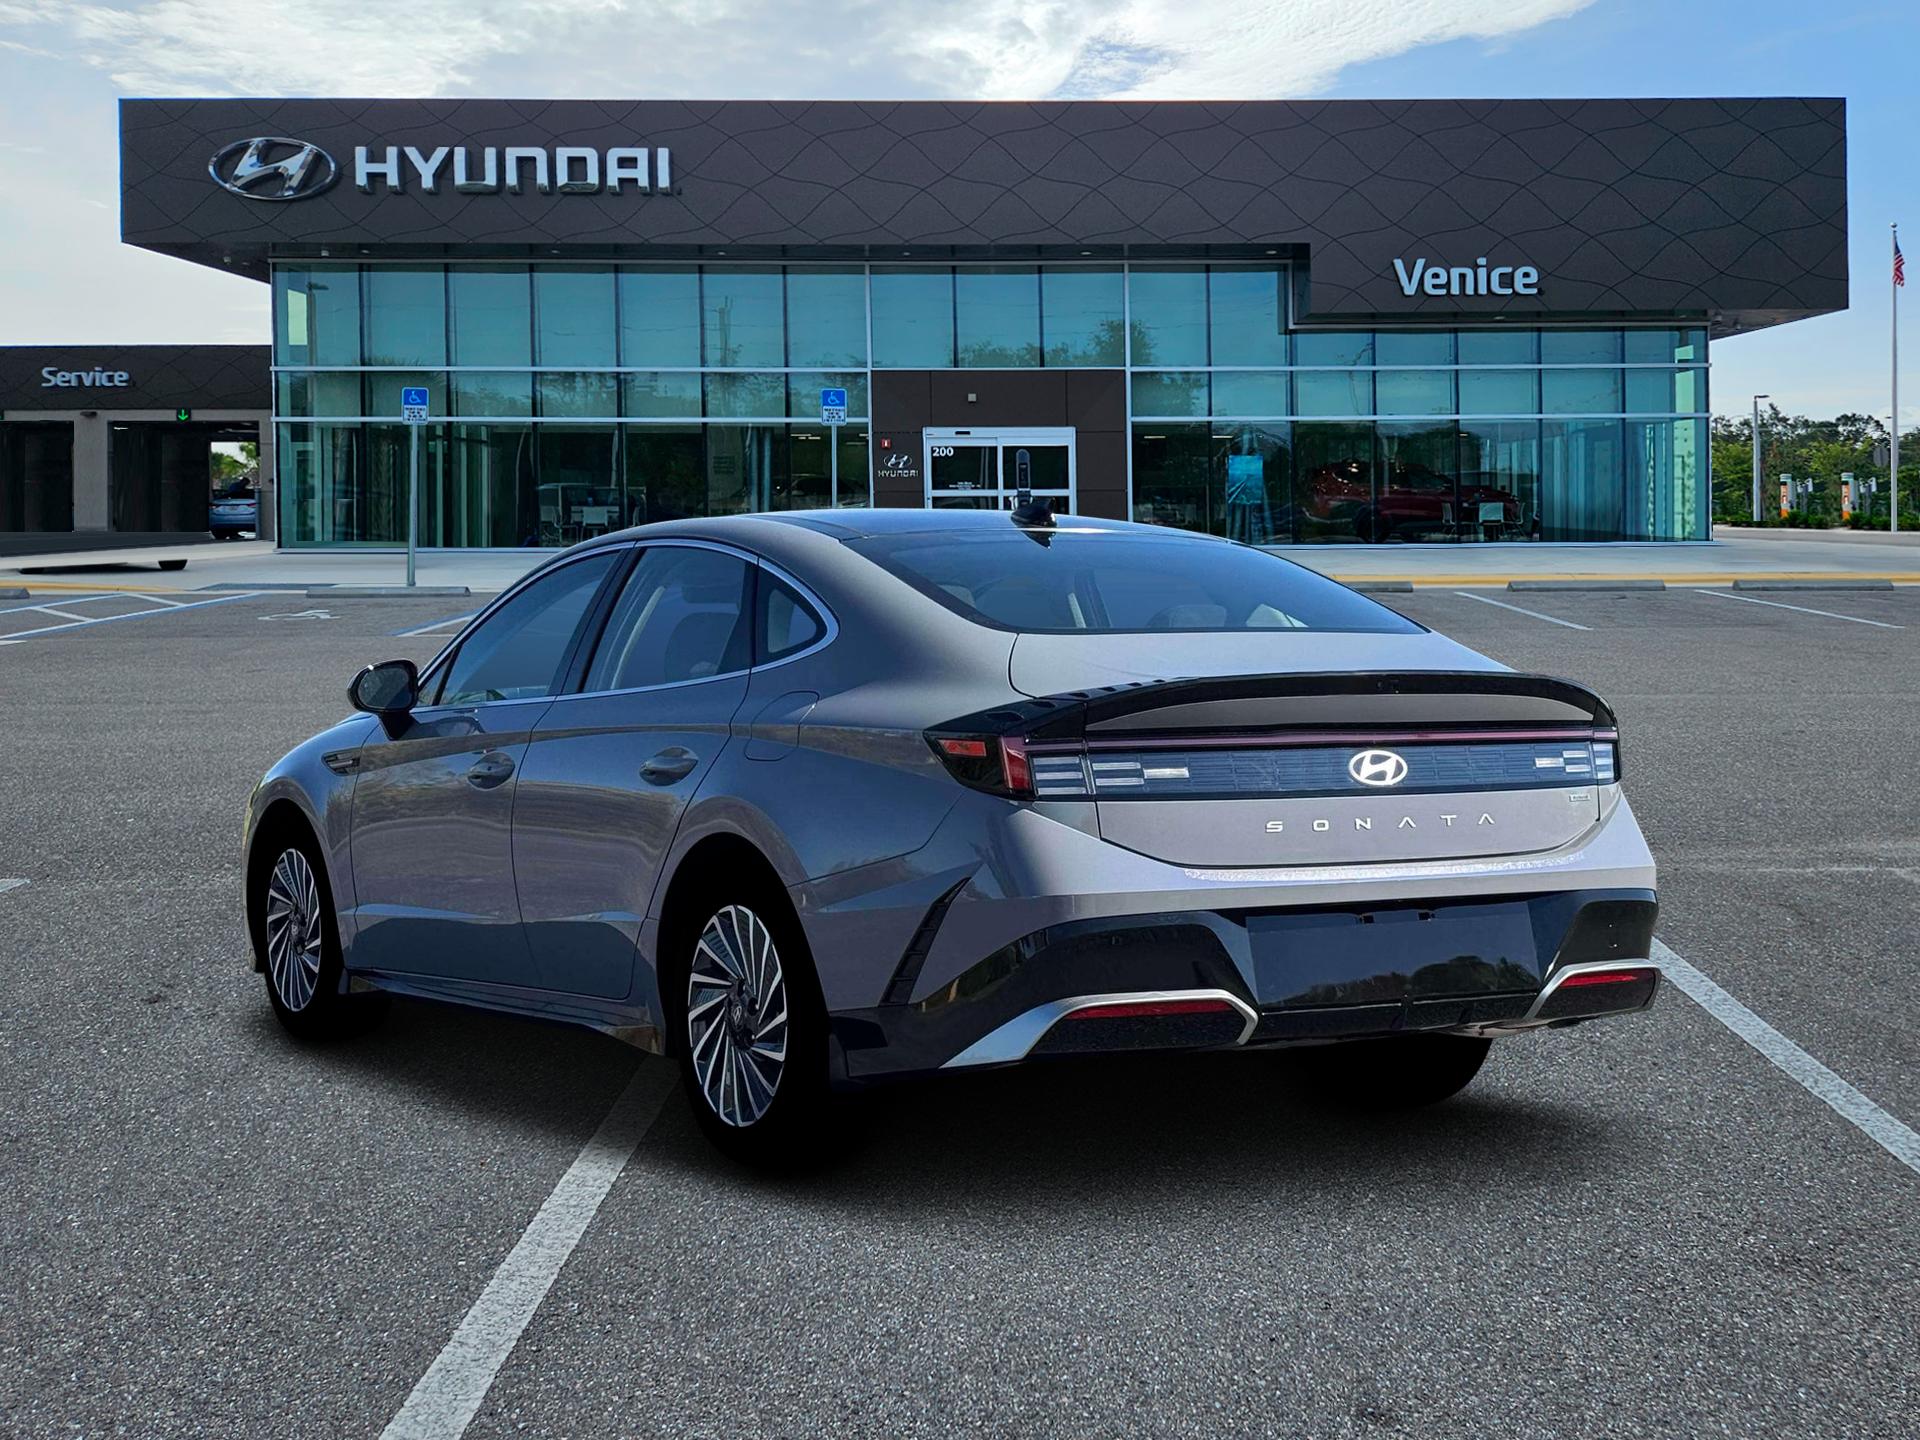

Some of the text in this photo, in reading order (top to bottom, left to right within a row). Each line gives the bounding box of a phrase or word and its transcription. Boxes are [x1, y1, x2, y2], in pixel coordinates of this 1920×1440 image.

[354, 146, 672, 194] HYUNDAI
[1393, 257, 1539, 296] Venice
[41, 366, 129, 387] Service
[932, 447, 954, 457] 200
[877, 470, 919, 478] HYUNDAI
[1265, 813, 1496, 833] SONATA
